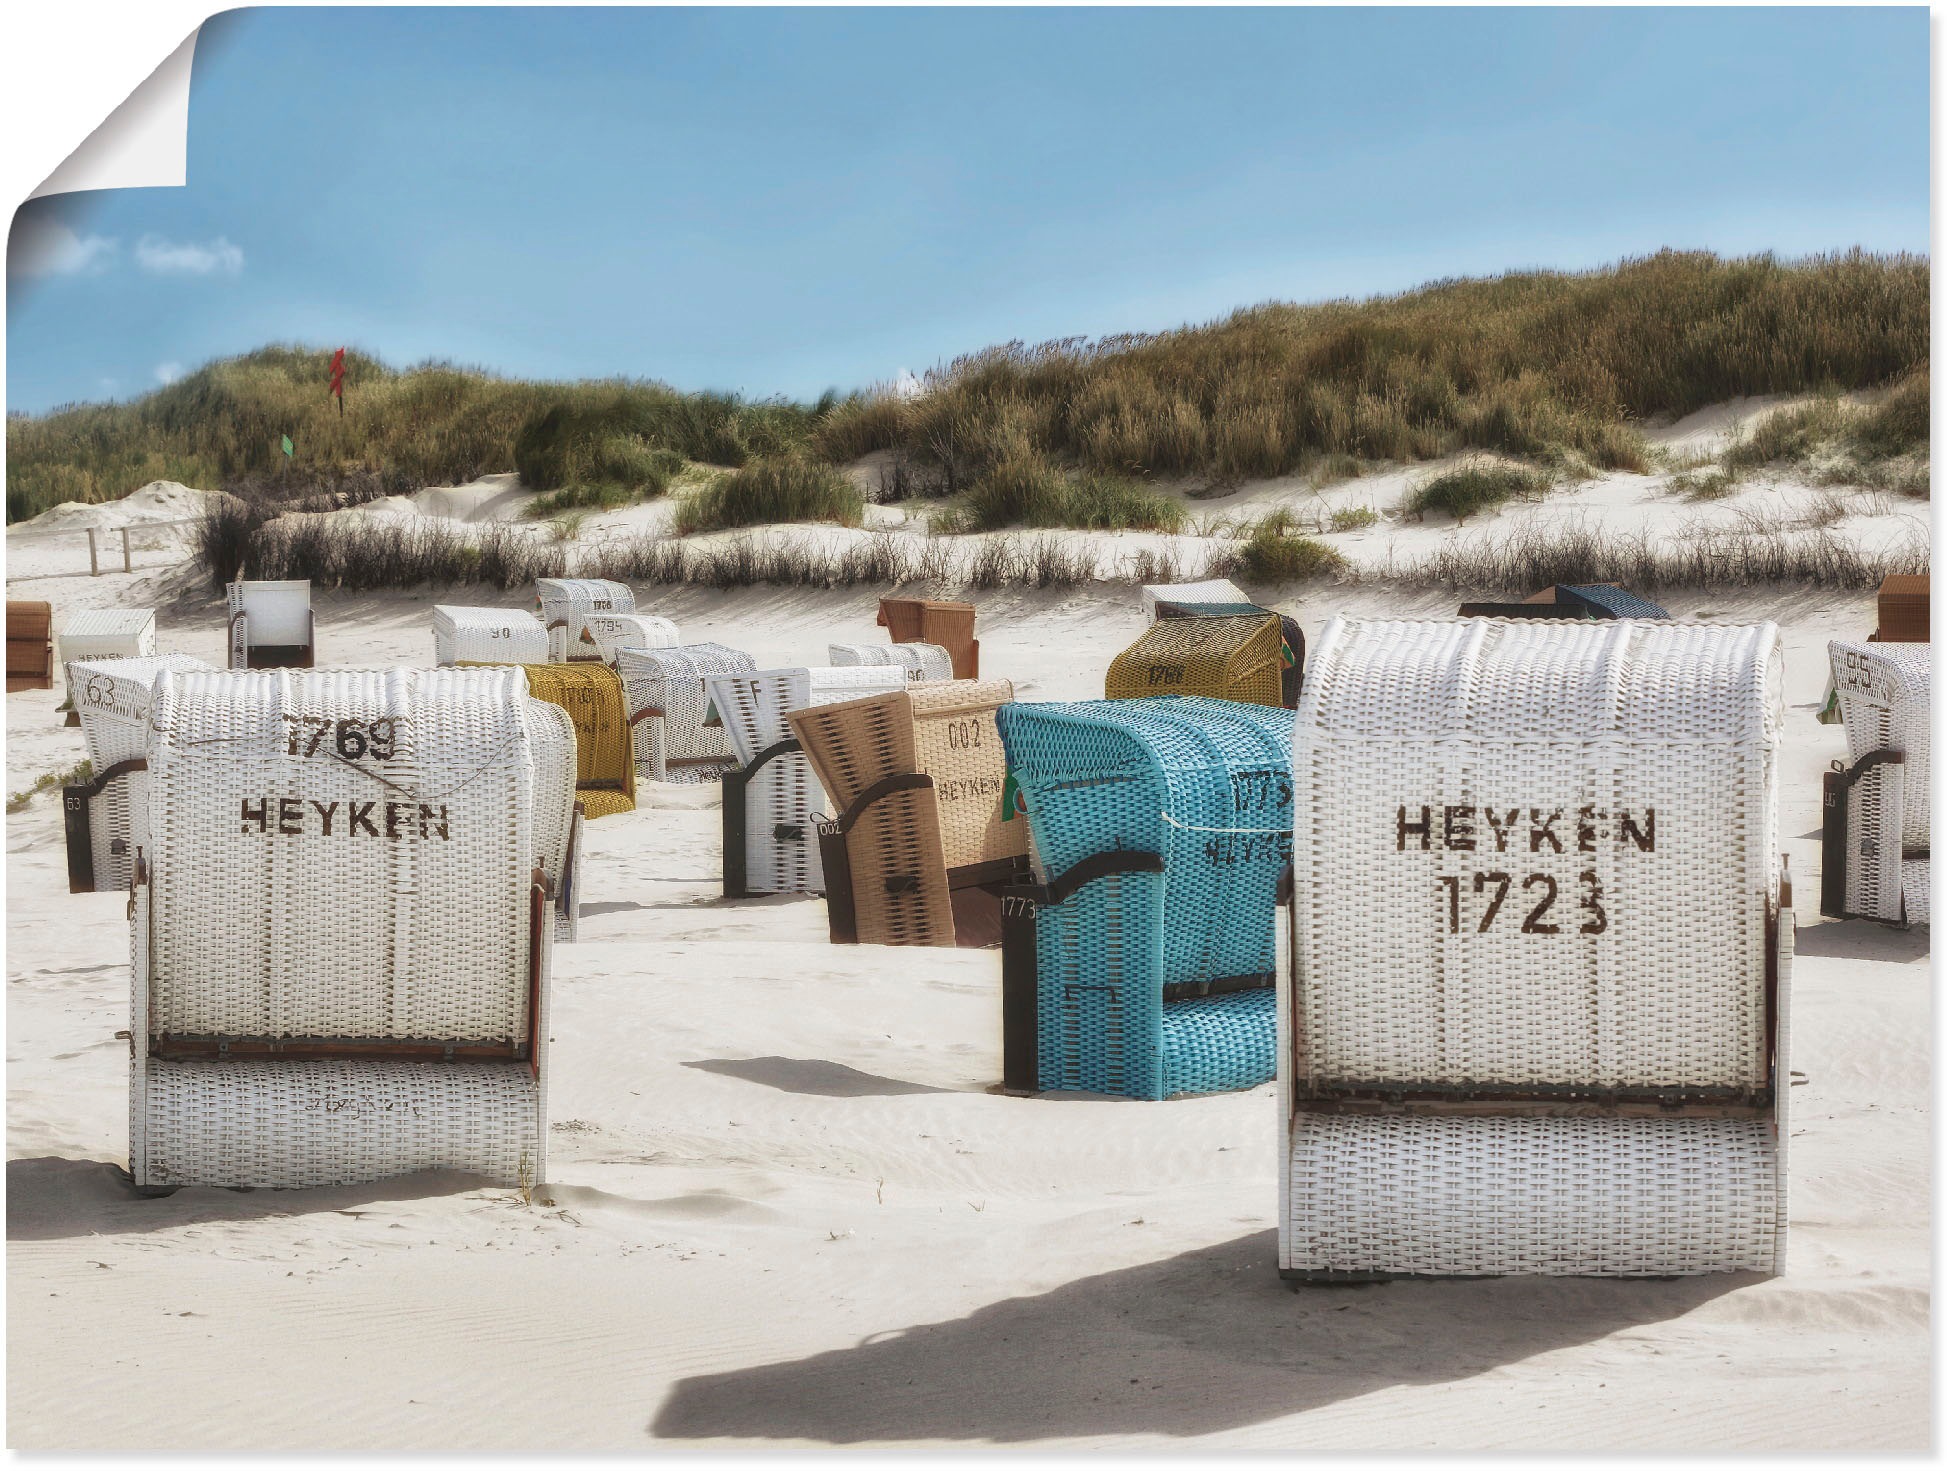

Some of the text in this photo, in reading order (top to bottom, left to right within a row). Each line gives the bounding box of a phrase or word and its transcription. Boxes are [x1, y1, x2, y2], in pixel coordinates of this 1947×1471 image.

[88, 675, 115, 705] 63
[282, 713, 397, 760] 1769
[949, 719, 981, 750] 002
[939, 775, 1000, 800] HEYKEN
[67, 797, 81, 810] 63
[241, 798, 450, 841] HEYKEN
[819, 823, 843, 836] 002
[1396, 804, 1656, 854] HEYKEN
[1001, 896, 1036, 919] 1773
[1436, 871, 1608, 935] 1723
